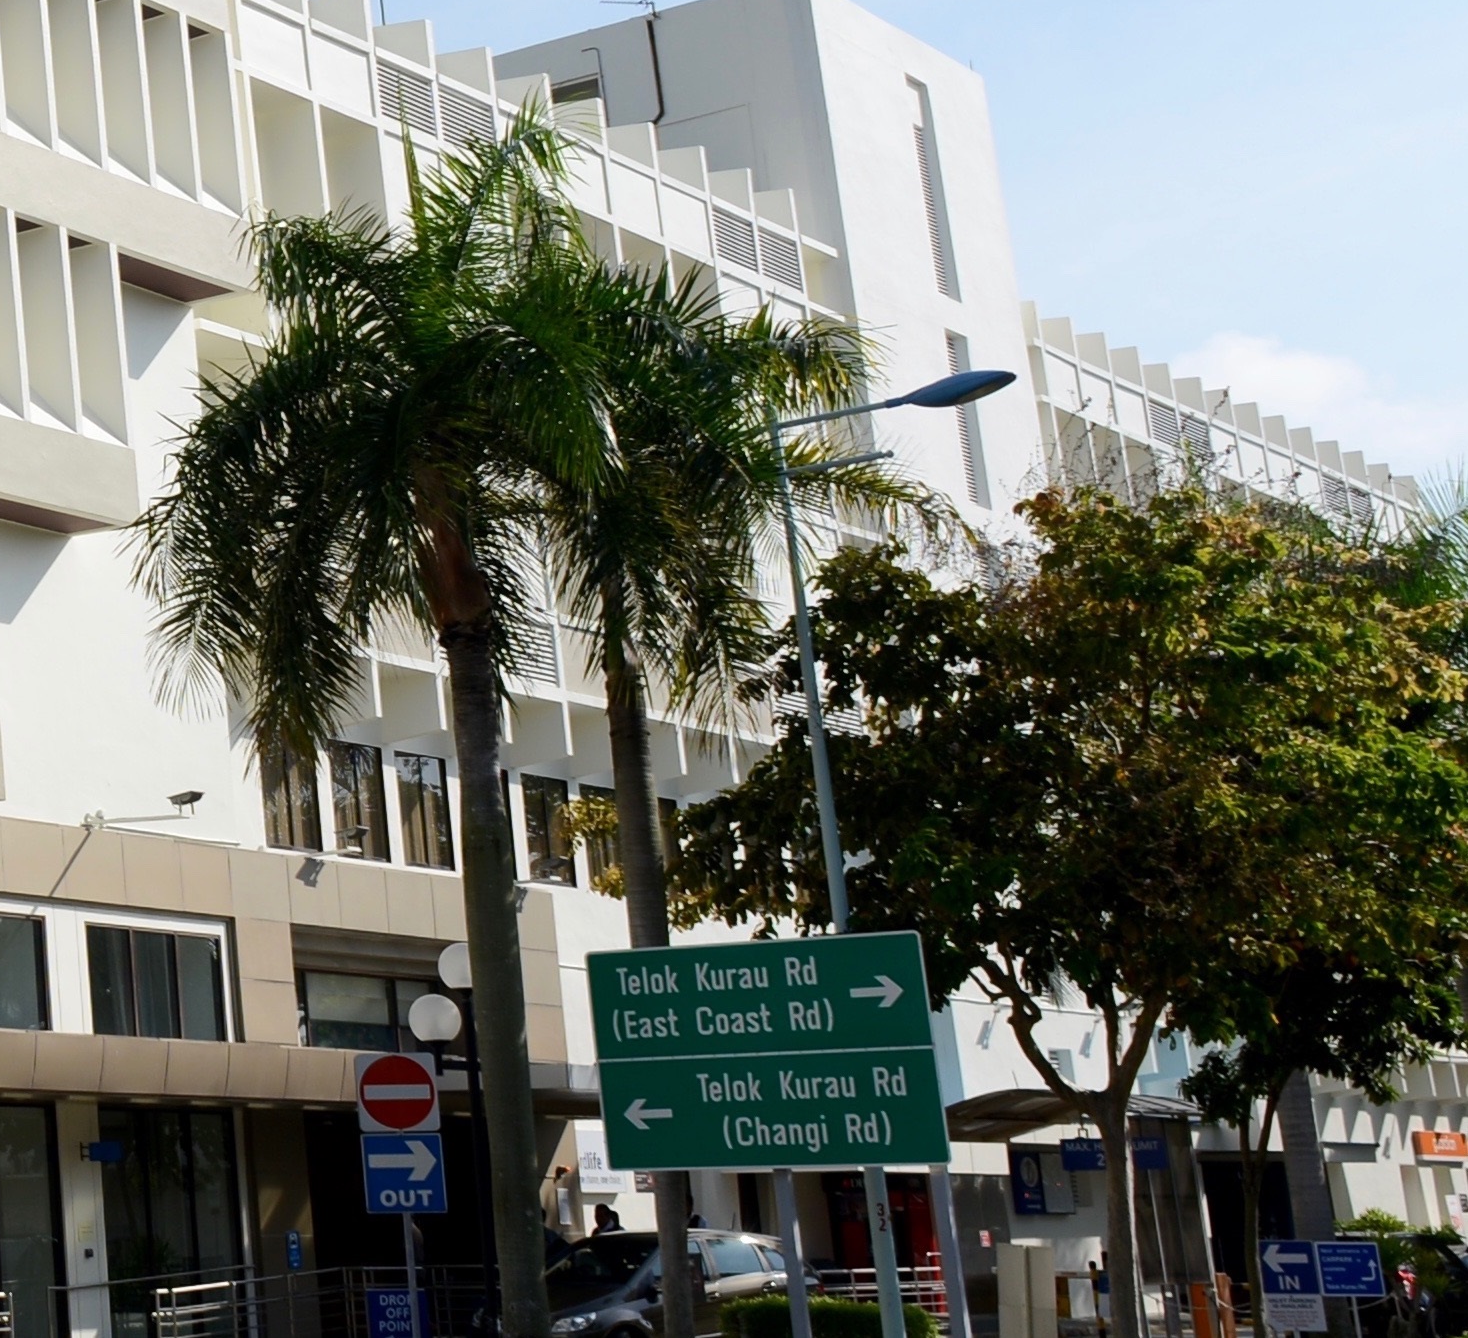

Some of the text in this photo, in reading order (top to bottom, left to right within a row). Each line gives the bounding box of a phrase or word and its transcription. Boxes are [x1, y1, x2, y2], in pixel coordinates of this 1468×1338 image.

[616, 956, 818, 995] Telok Kurau Rd
[613, 998, 834, 1042] (East Coast Rd)
[696, 1066, 907, 1103] Telok Kurau Rd
[723, 1110, 892, 1152] (Changi Rd)
[380, 1189, 432, 1207] OUT
[1278, 1275, 1300, 1291] IN
[379, 1320, 411, 1332] POIN
[385, 1307, 410, 1319] OFF
